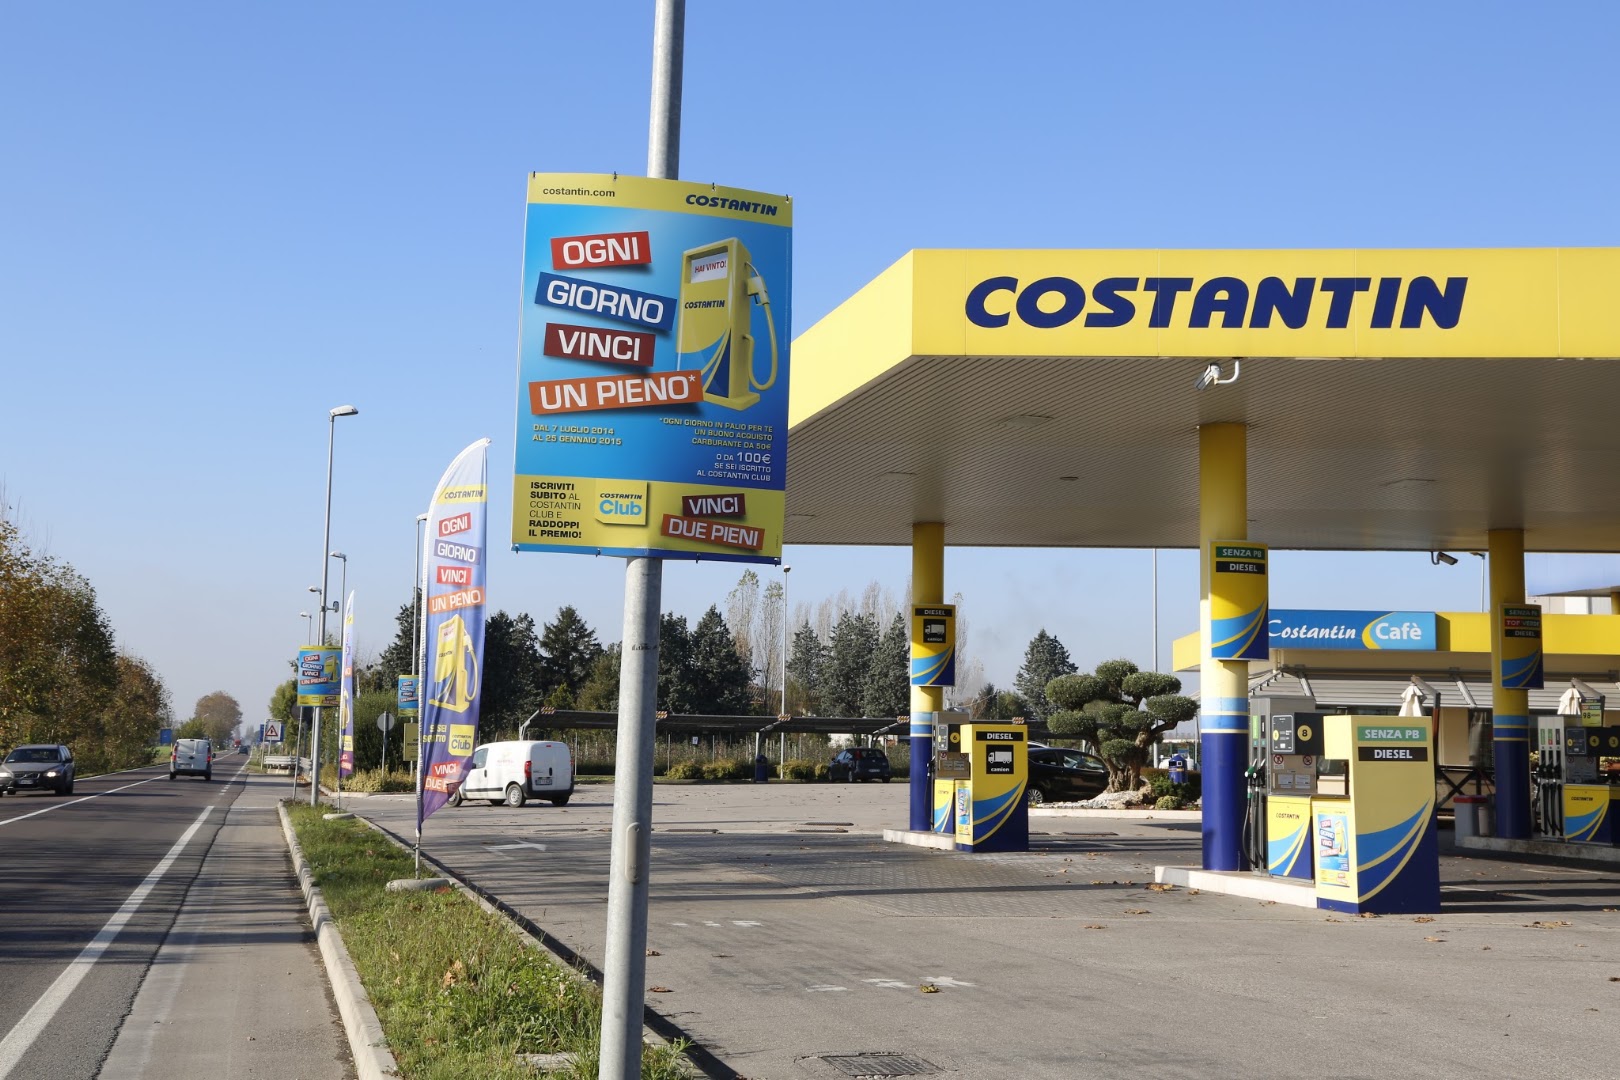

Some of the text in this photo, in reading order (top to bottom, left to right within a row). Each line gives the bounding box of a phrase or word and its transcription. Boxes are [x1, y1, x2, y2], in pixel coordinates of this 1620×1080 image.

[542, 187, 615, 198] costantin.com
[686, 194, 777, 216] COSTANTIN
[563, 236, 639, 265] OGNI
[694, 260, 726, 273] HAI VINTO!
[546, 280, 664, 324] GIORNO
[684, 300, 725, 309] COSTANTIN
[965, 276, 1468, 330] COSTANTIN
[557, 329, 640, 362] VINCI
[540, 383, 587, 410] UN
[533, 424, 550, 432] DAL
[560, 425, 589, 434] LUGLIO
[684, 419, 713, 428] GIORNO
[559, 435, 597, 444] GENNAIO
[736, 432, 772, 441] ACQUISTO
[692, 438, 741, 448] CARBURANTE
[737, 452, 771, 464] 100€
[739, 465, 771, 473] ISCRITTO
[708, 471, 750, 480] COSTANTIN
[530, 482, 574, 490] ISCRIVITI
[444, 490, 483, 499] COSTANTIN
[530, 492, 566, 500] SUBITO
[530, 501, 581, 510] COSTANTIN
[599, 499, 642, 516] Club
[688, 497, 739, 515] VINCI
[530, 510, 554, 518] CLUB
[442, 516, 468, 534] OGNI
[529, 520, 579, 529] RADDOPPI
[540, 530, 582, 538] PREMIO!
[669, 518, 708, 539] DUE
[710, 524, 759, 547] PIENI
[437, 543, 476, 562] GIORNO
[1222, 549, 1252, 557] SENZA
[1229, 563, 1257, 572] DIESEL
[441, 568, 466, 583] VINCI
[432, 597, 446, 612] UN
[1375, 623, 1422, 640] Cafè
[1365, 729, 1420, 739] SENZA PB
[452, 739, 471, 750] Club
[1374, 750, 1413, 758] DIESEL
[434, 763, 457, 775] VINCI
[425, 778, 441, 789] DUE
